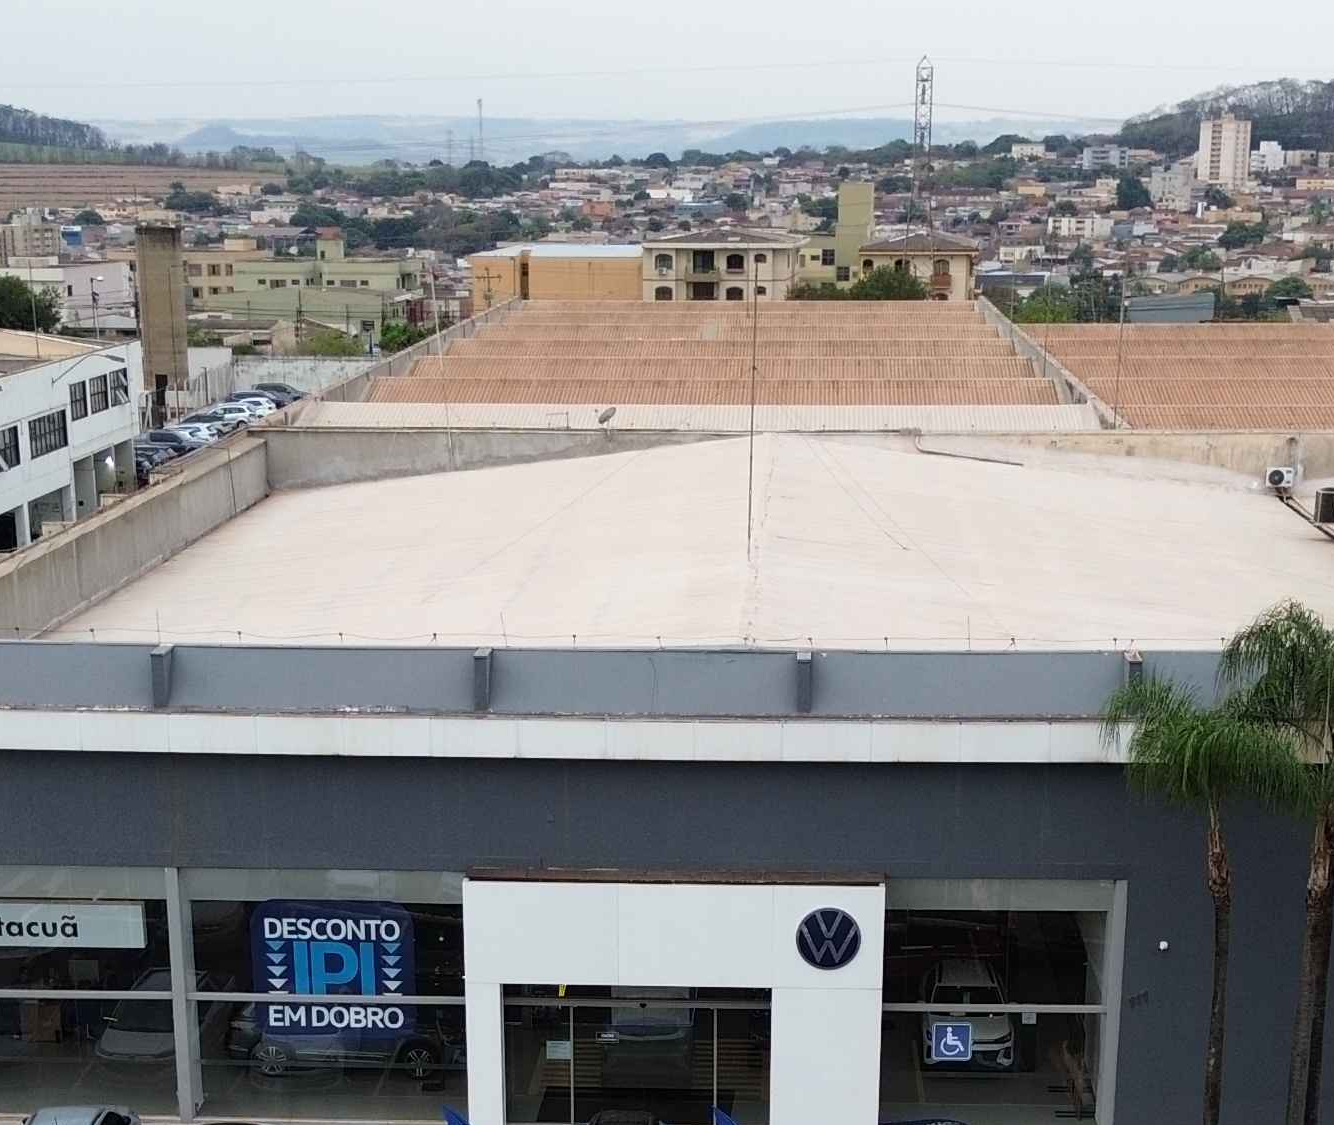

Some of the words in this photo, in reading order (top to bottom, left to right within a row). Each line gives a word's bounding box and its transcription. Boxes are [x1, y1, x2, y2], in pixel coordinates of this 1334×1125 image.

[264, 917, 401, 941] DESCONTO
[293, 941, 376, 998] IPI
[269, 1005, 307, 1027] EM
[311, 1006, 405, 1029] DOBRO
